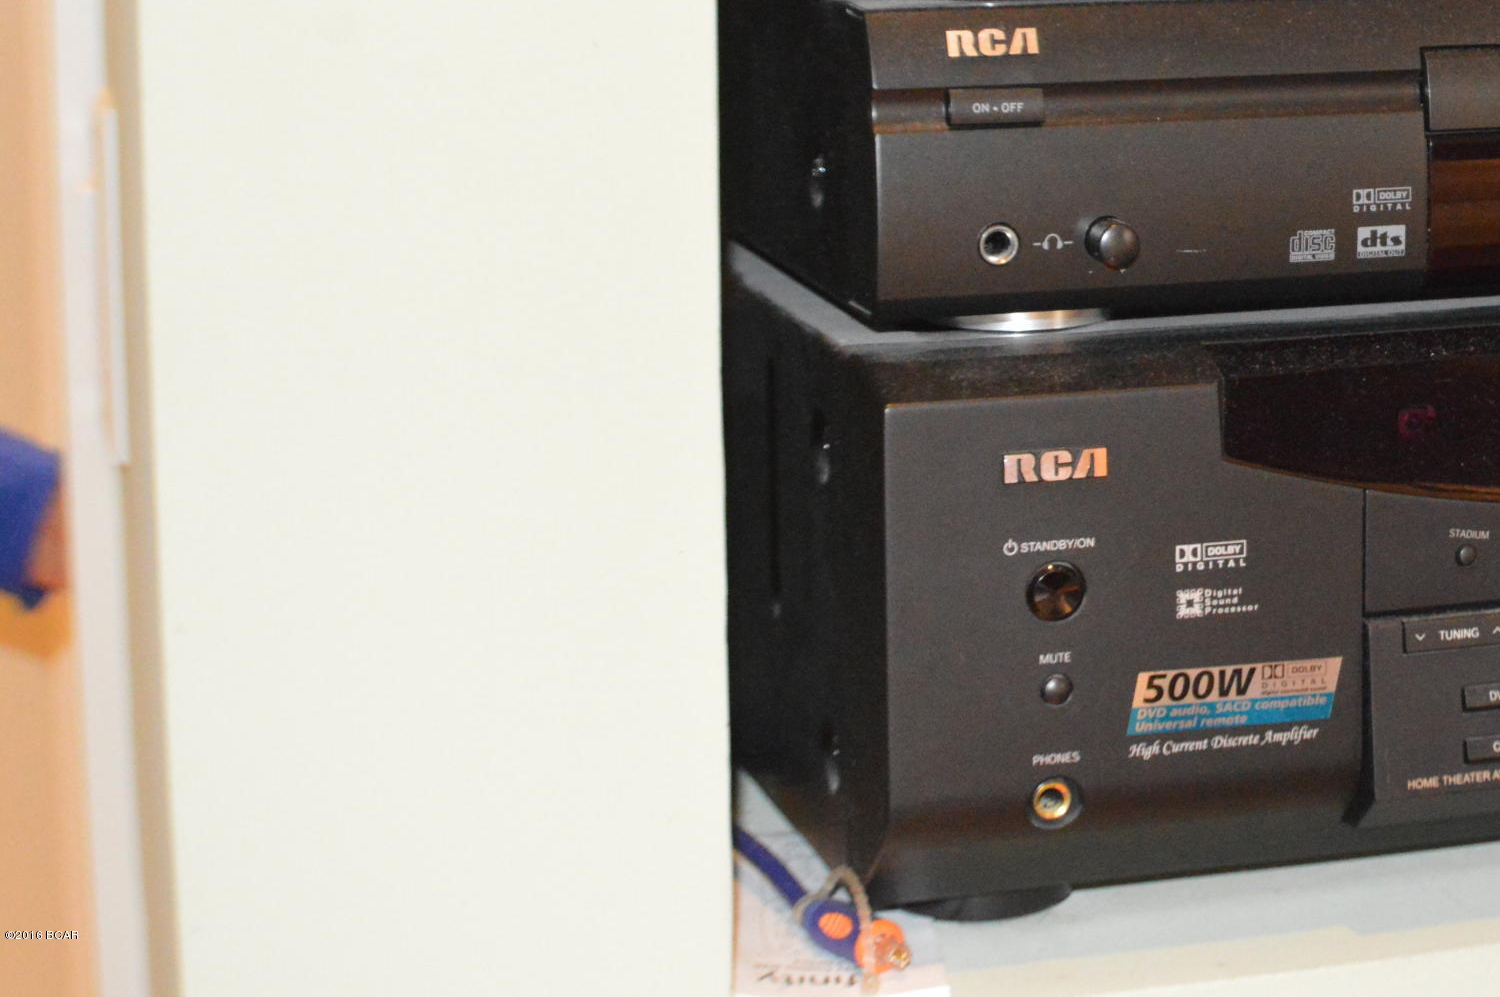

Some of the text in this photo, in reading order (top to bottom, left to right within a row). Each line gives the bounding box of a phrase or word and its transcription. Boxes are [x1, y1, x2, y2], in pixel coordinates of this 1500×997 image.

[945, 27, 1040, 58] RCA
[972, 102, 990, 113] ON
[1001, 102, 1025, 113] OFF
[1378, 190, 1408, 200] DOLBY
[1353, 203, 1412, 213] DIGITAL
[1360, 229, 1403, 248] dts
[1003, 447, 1108, 484] RCA
[1449, 528, 1490, 540] STADIUM
[1020, 537, 1096, 554] STANDBY/ON
[1207, 545, 1242, 556] DOLBY
[1175, 558, 1247, 573] DIGITAL
[1204, 587, 1243, 598] Digital
[1204, 597, 1239, 607] Sound
[1204, 604, 1260, 616] Processor
[1438, 627, 1480, 641] TUNING
[1038, 651, 1072, 666] MUTE
[1290, 664, 1323, 674] DOLBY
[1143, 666, 1257, 705] 500W
[1261, 677, 1328, 690] DIGITAL
[1137, 707, 1168, 720] DVD
[1215, 701, 1251, 714] SACD
[1254, 694, 1328, 711] compatible
[1135, 714, 1248, 733] Universal remote
[1128, 725, 1320, 761] High Current Discrete Amplifier
[1032, 750, 1081, 767] PHONES
[1407, 778, 1440, 791] HOME
[1443, 770, 1491, 786] THEATER
